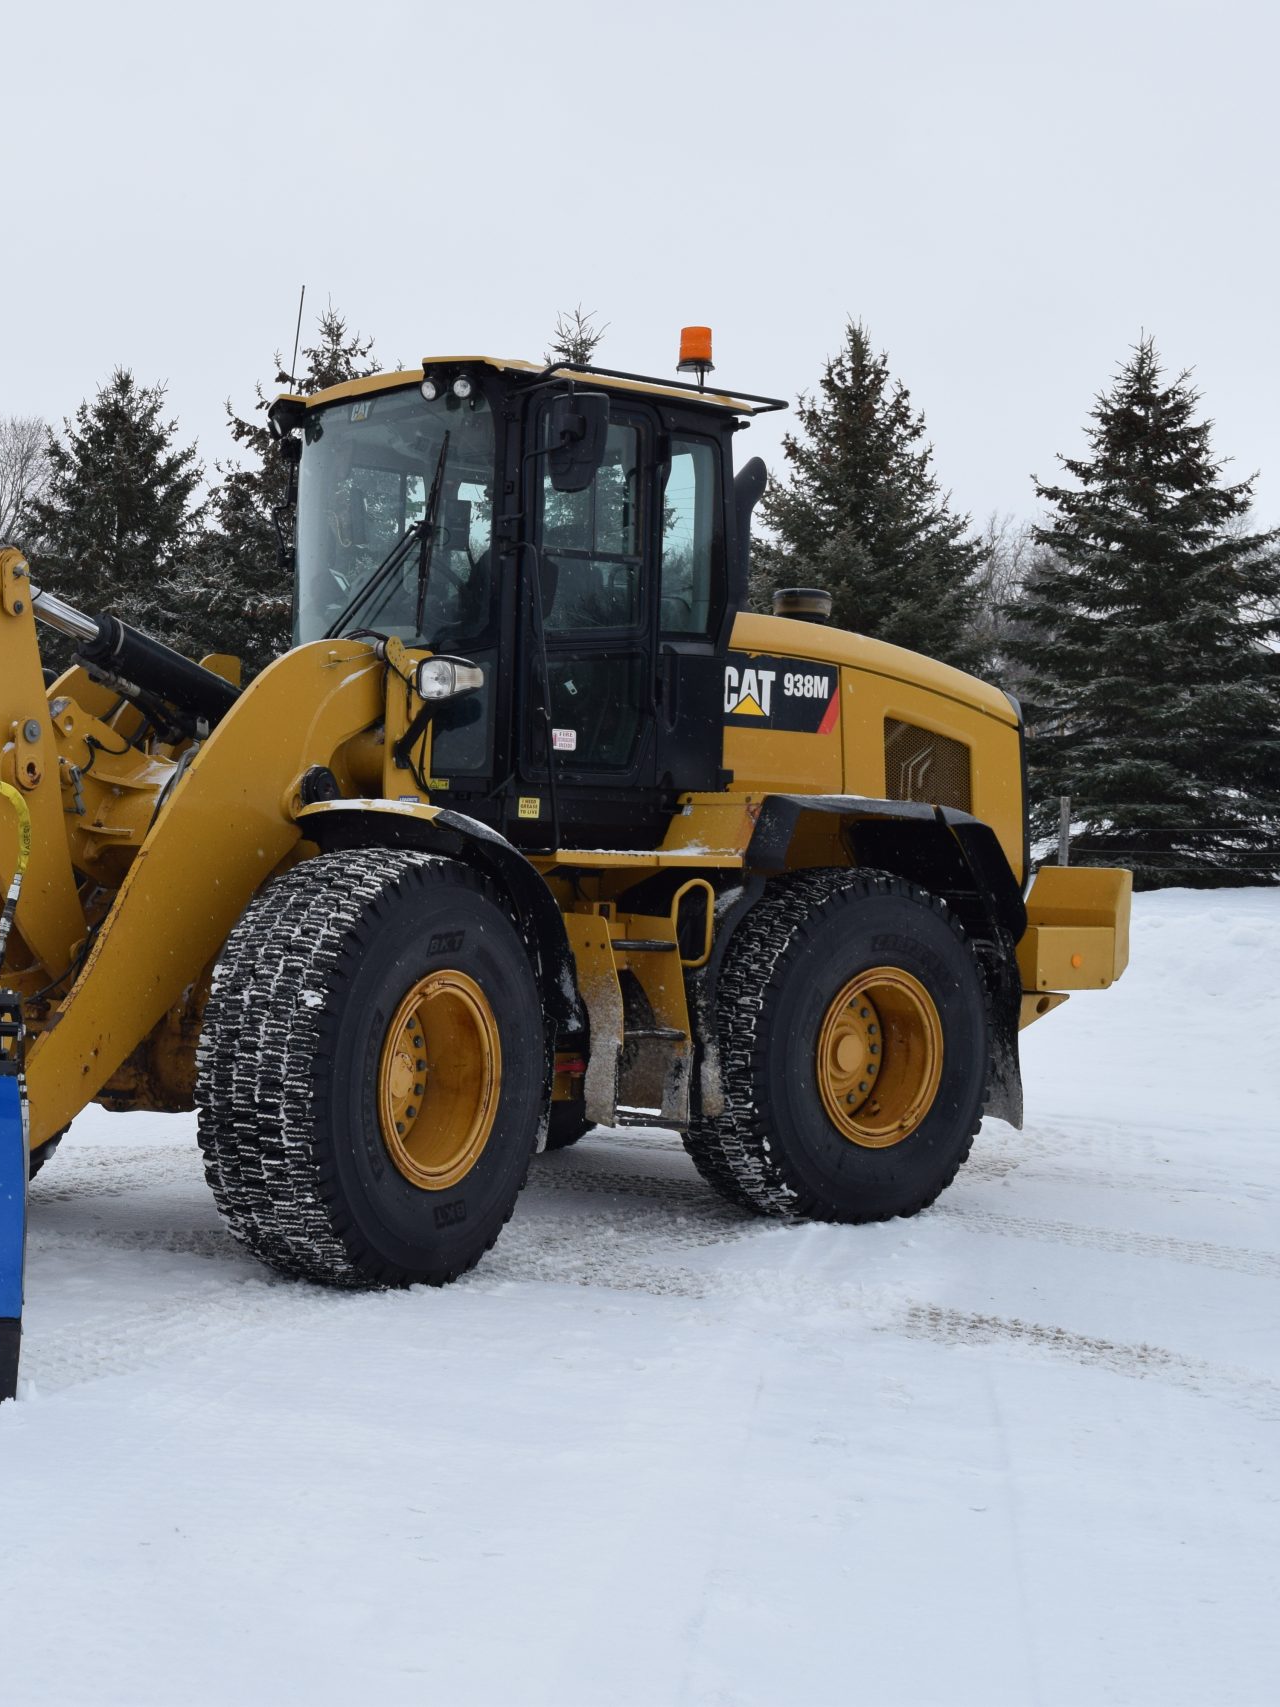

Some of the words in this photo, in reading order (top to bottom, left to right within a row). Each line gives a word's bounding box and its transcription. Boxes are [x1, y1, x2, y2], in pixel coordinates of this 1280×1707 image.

[351, 402, 371, 421] CAT
[724, 666, 776, 717] CAT
[783, 672, 829, 699] 938M
[430, 935, 463, 952] BKT
[438, 1203, 464, 1223] BKT
